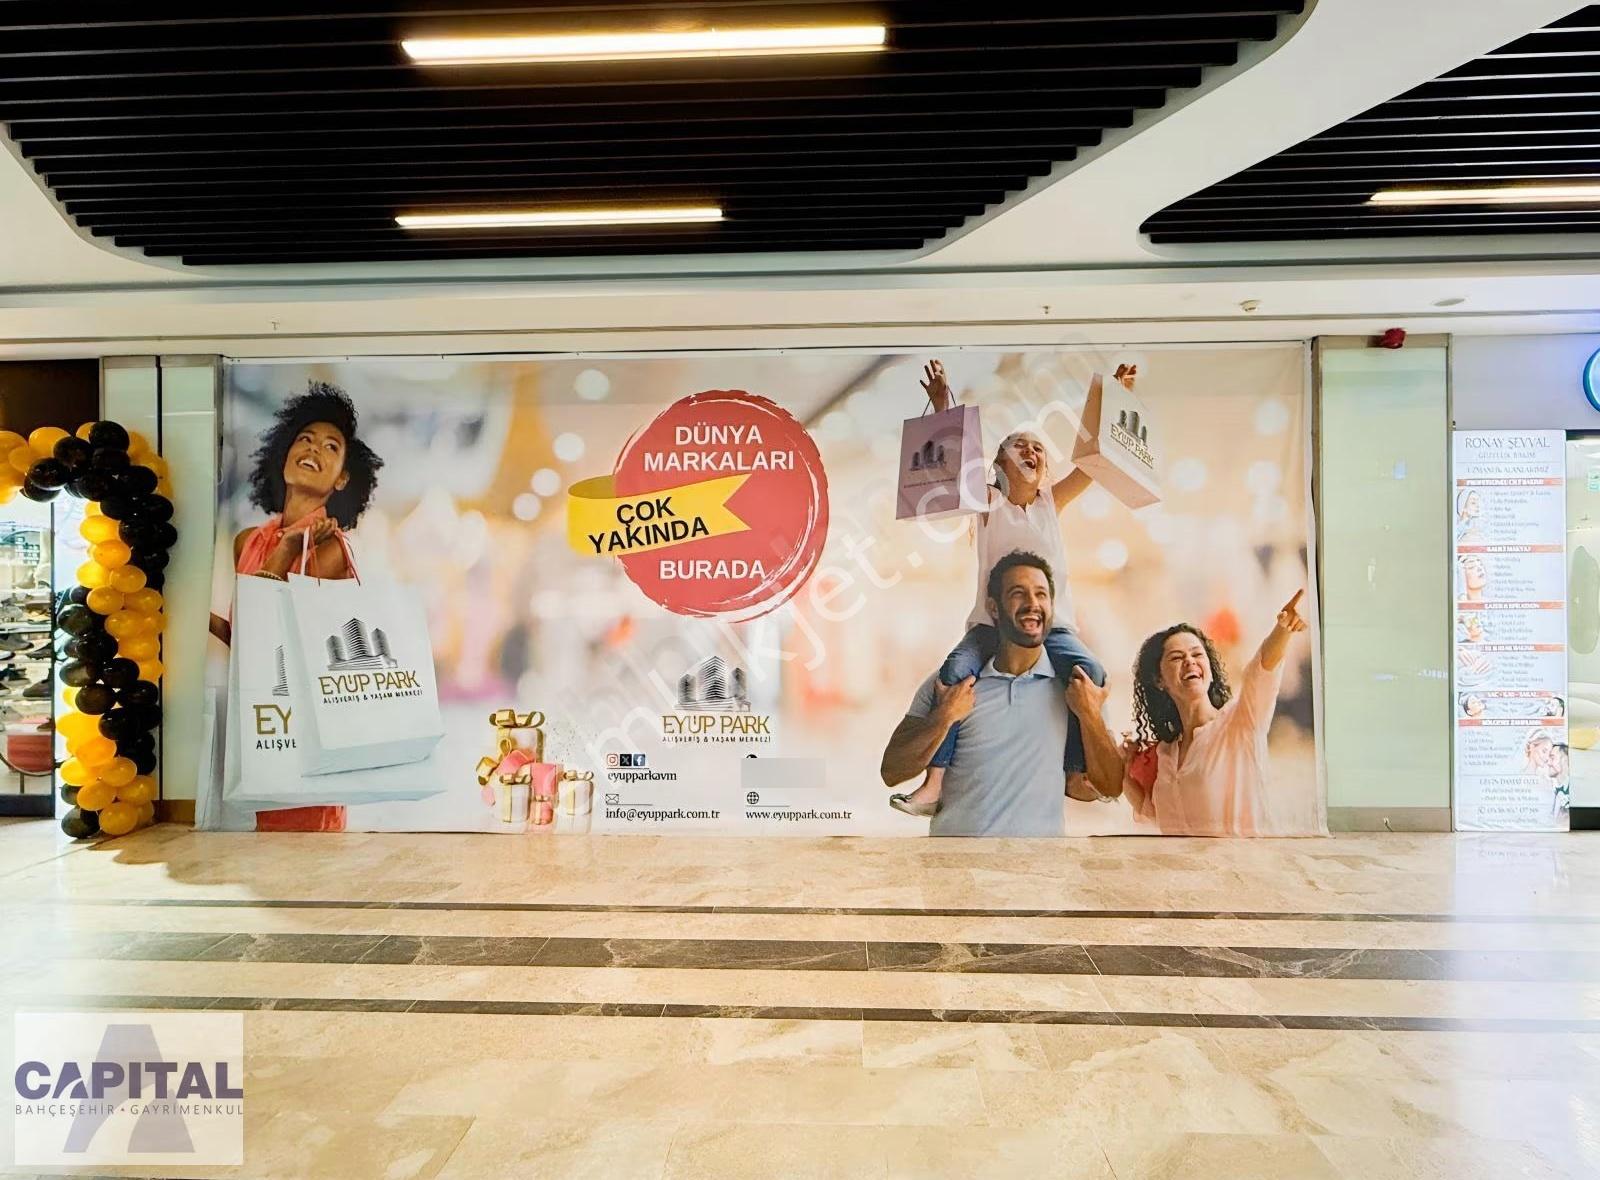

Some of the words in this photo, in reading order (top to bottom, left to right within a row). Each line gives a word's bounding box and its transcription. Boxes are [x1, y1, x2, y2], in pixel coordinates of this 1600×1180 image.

[675, 422, 763, 446] DÜNYA
[1465, 437, 1504, 449] RONAY
[644, 451, 795, 472] MARKALARI
[616, 496, 676, 527] ÇOK
[588, 516, 710, 554] YAKINDA
[659, 560, 767, 580] BURADA
[373, 670, 421, 691] PARK
[253, 704, 292, 735] EY
[719, 715, 771, 734] PARK
[607, 770, 677, 783] eyupparkavm
[605, 808, 721, 821] info@eyuppark.com.tr
[746, 809, 852, 821] www.eyuppark.com.tr
